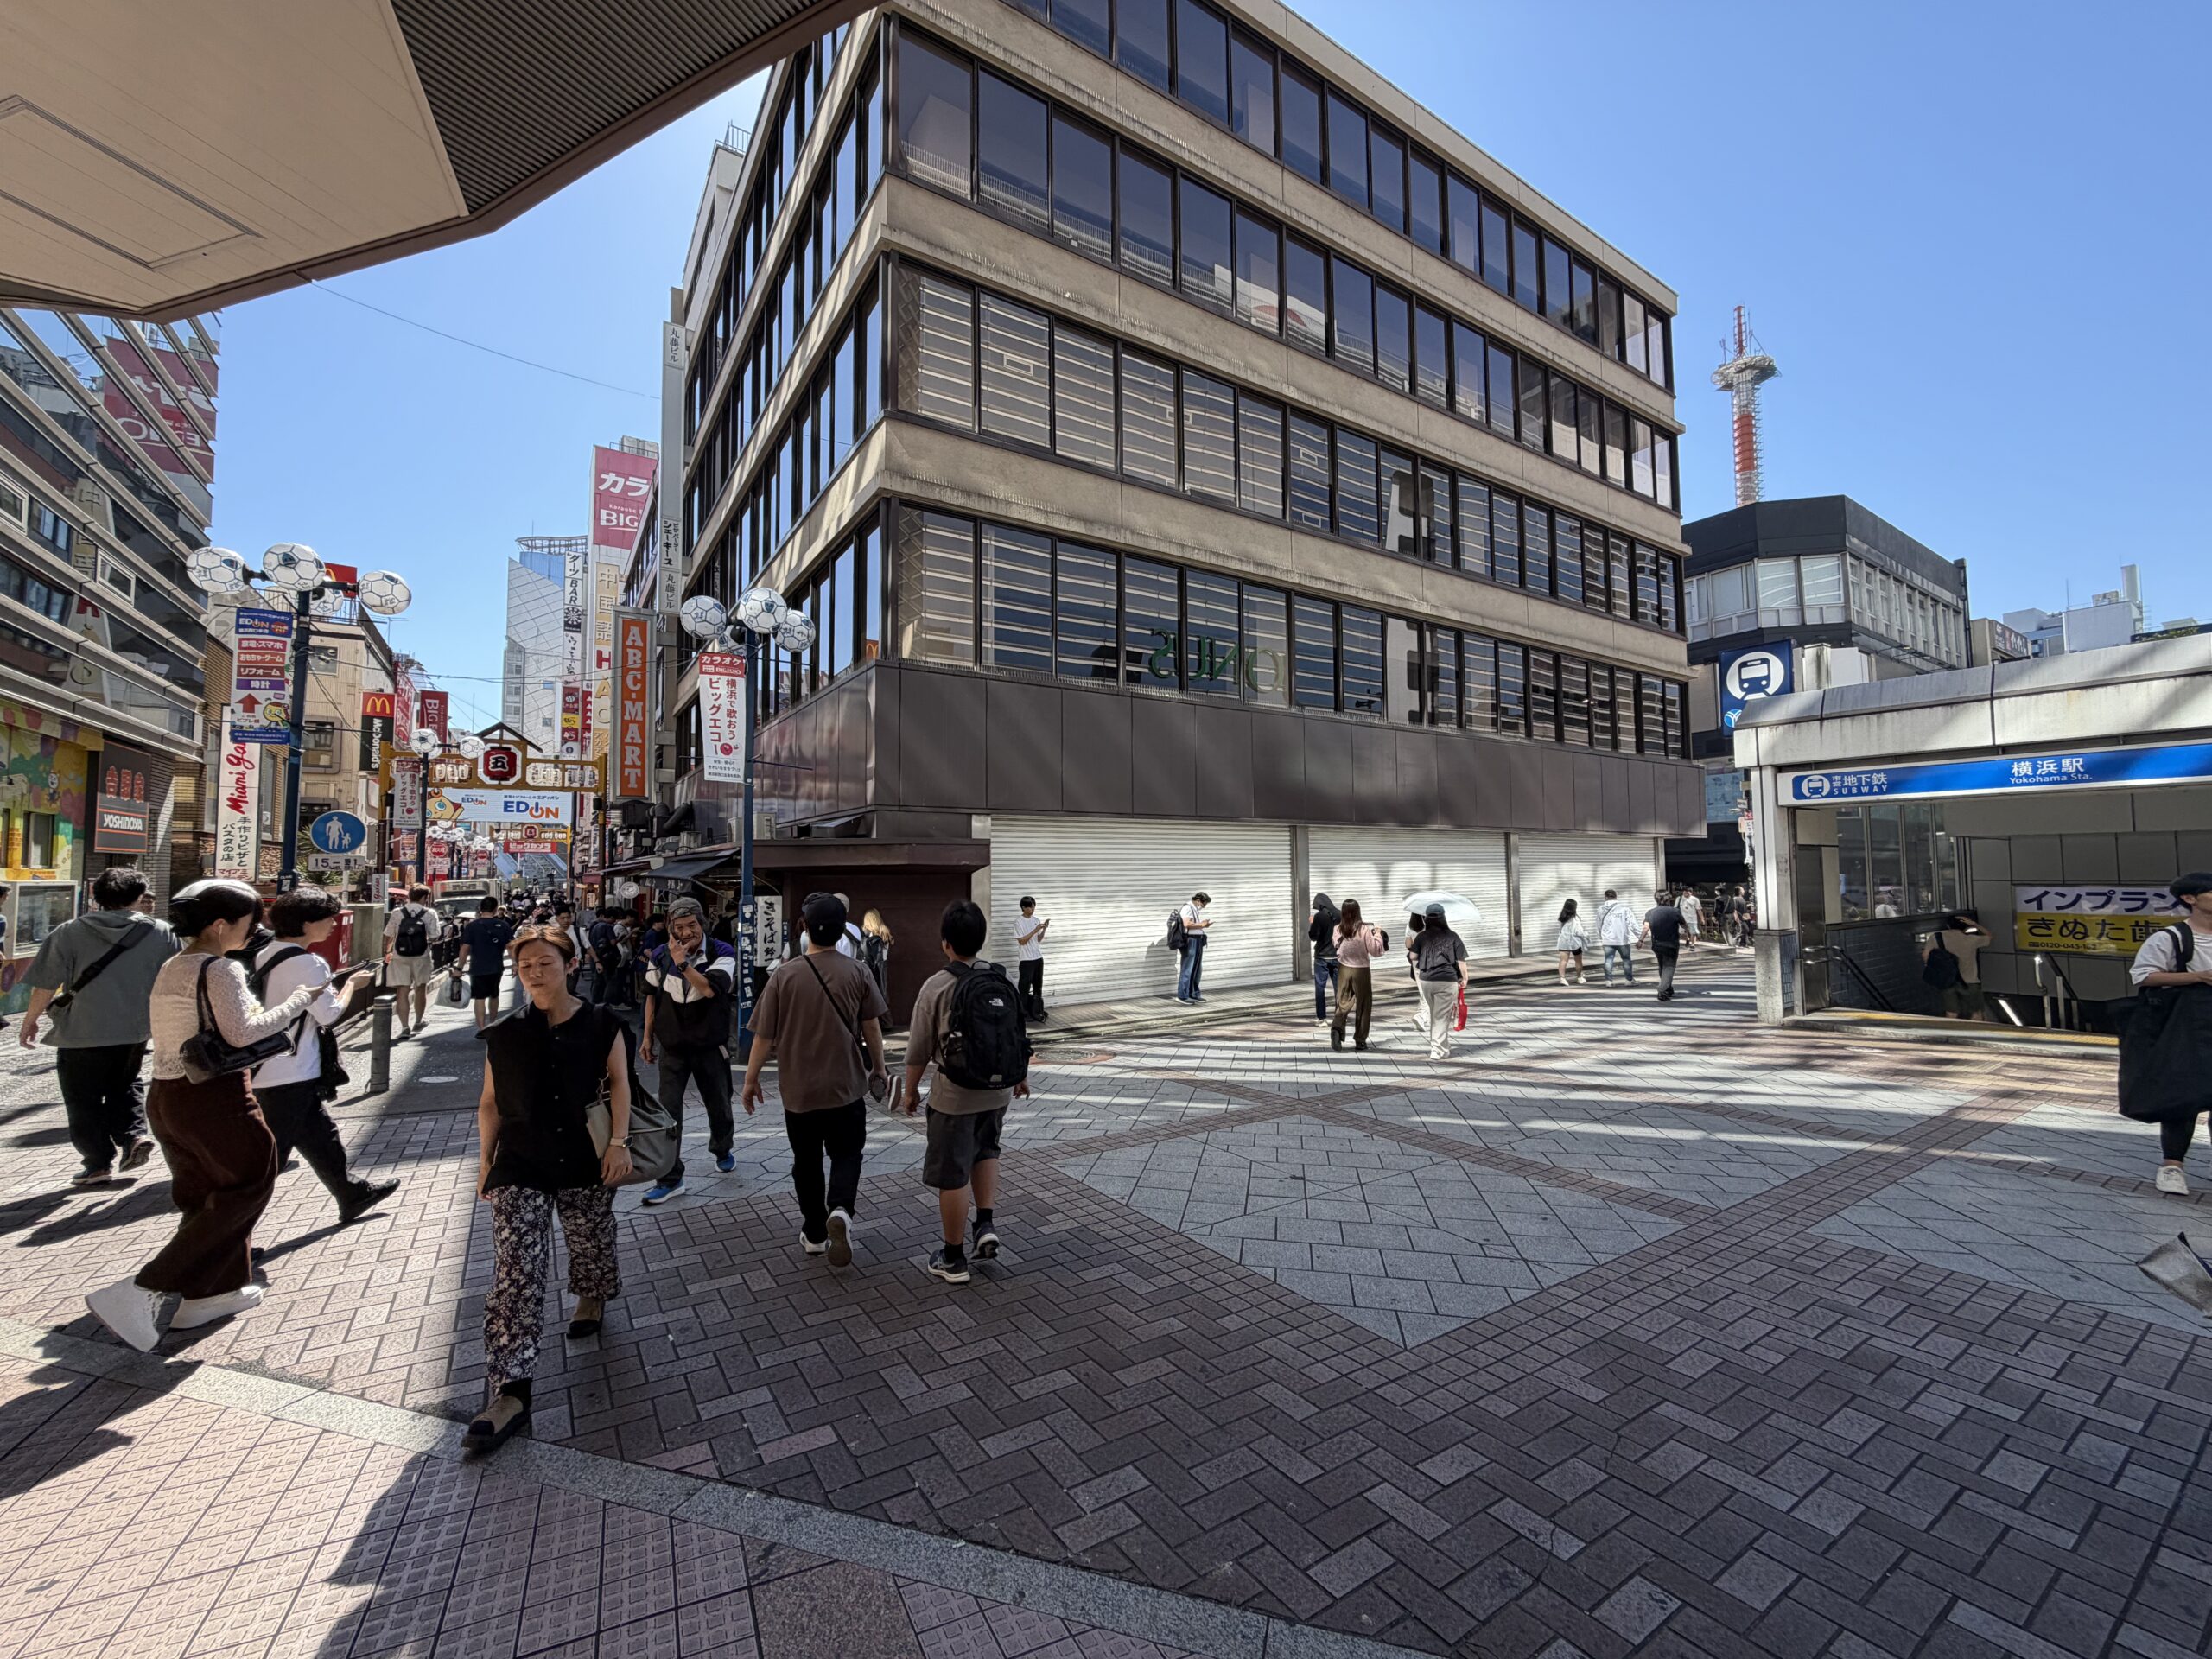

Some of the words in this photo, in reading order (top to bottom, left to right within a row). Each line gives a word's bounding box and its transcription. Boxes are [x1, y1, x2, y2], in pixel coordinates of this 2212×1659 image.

[600, 509, 639, 528] BIG
[569, 581, 579, 605] BAR
[701, 655, 741, 667] カラオケ
[240, 667, 281, 677] リフォーム
[251, 680, 271, 690] 時計
[708, 677, 721, 756] ビッグエコー
[726, 677, 738, 741] 横浜で歌おう
[371, 718, 383, 770] McDonald's
[489, 755, 508, 772] 五
[2011, 757, 2085, 778] 横浜駅
[2009, 774, 2068, 786] Yokohama
[2070, 773, 2094, 782] Sta.
[226, 770, 250, 815] Miami
[1833, 785, 1888, 795] SUBWAY
[461, 797, 487, 806] EDION
[503, 801, 559, 819] EDION
[103, 813, 143, 831] YOSHINOYA
[221, 823, 236, 862] パスタの店
[236, 816, 252, 868] 手作りピザと
